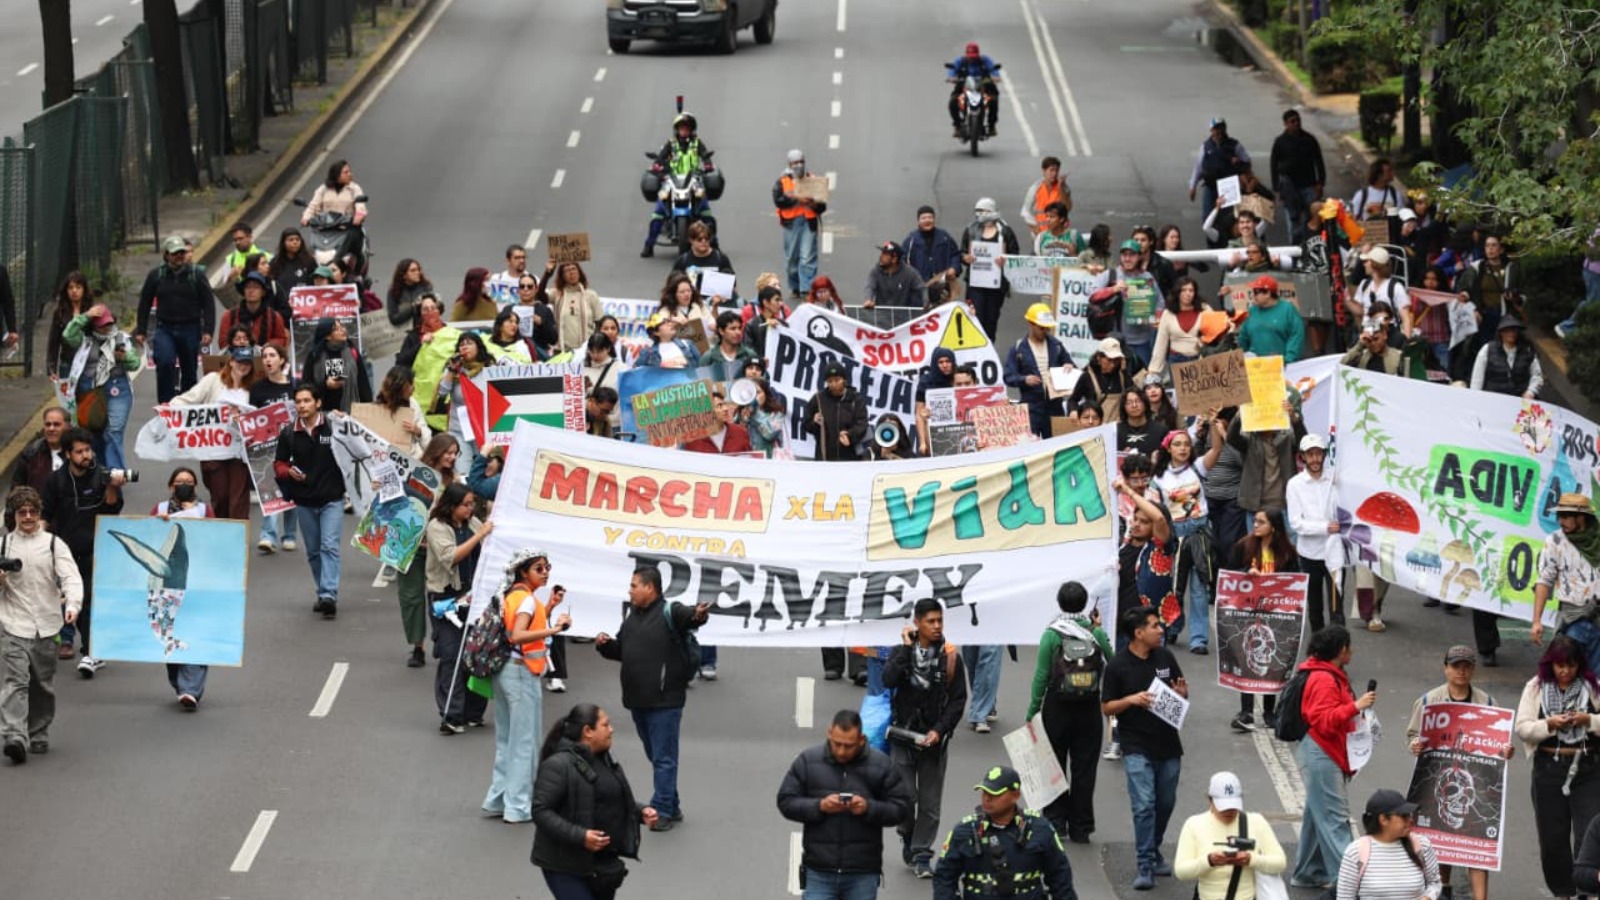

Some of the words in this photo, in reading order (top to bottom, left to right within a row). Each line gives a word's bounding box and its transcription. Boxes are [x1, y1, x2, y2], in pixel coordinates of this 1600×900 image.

[1063, 280, 1092, 296] YOU
[293, 296, 316, 307] NO
[857, 327, 895, 341] NO
[910, 313, 940, 336] ES
[863, 339, 925, 367] SOLO
[1180, 366, 1199, 382] NO
[634, 394, 649, 410] LA
[652, 381, 708, 406] JUSTICIA
[159, 408, 183, 429] TU
[186, 406, 231, 427] PEME
[243, 415, 269, 432] NO
[539, 462, 764, 522] MARCHA
[603, 526, 623, 546] Y
[626, 530, 747, 558] CONTRA
[1222, 580, 1254, 593] NO
[1424, 713, 1449, 731] NO
[1453, 753, 1498, 766] FRACTURADA
